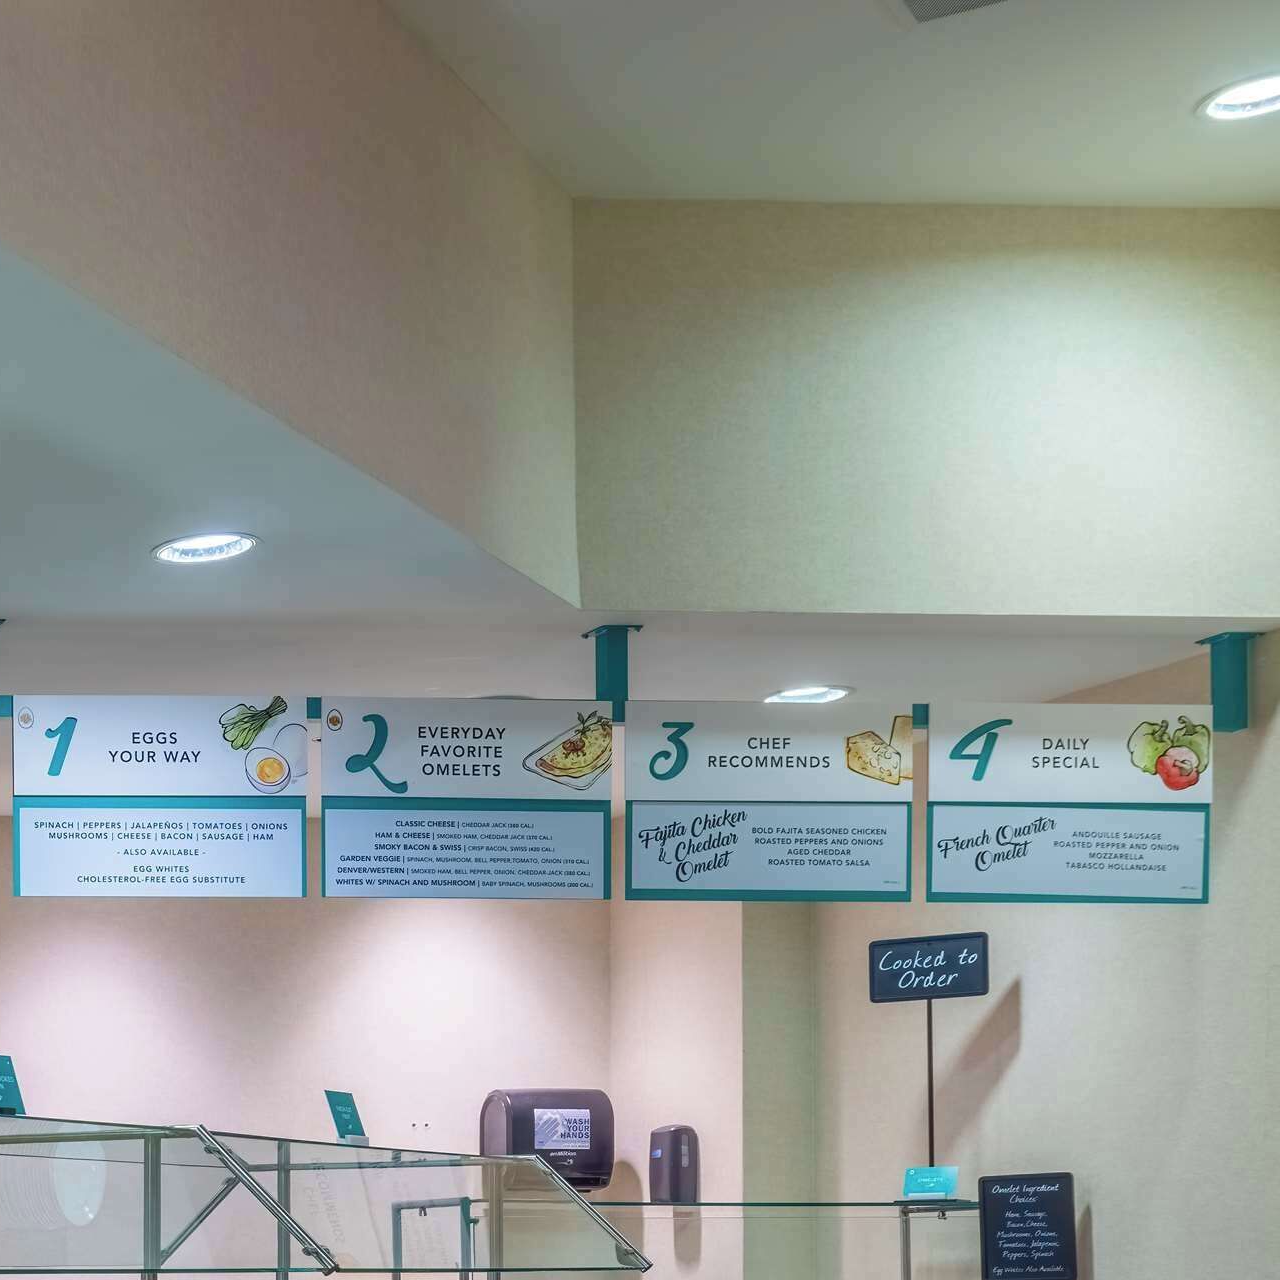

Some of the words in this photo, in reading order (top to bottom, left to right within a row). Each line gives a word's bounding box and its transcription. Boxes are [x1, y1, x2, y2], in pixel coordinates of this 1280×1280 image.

[131, 732, 178, 745] EGGS
[418, 726, 506, 739] EVERYDAY
[44, 717, 78, 776] 1
[747, 737, 791, 749] CHEF
[1042, 738, 1089, 750] DAILY
[108, 750, 156, 763] YOUR
[163, 751, 201, 763] WAY
[345, 714, 408, 794] 2
[420, 745, 503, 758] FAVORITE
[649, 722, 694, 780] 3
[949, 719, 1013, 781] 4
[708, 756, 830, 768] RECOMMENDS
[1032, 756, 1100, 769] SPECIAL
[422, 763, 501, 777] OMELETS
[34, 821, 74, 829] SPINACH
[83, 822, 121, 830] PEPPERS
[131, 820, 184, 830] JALAPEÑOS
[192, 822, 243, 830] TOMATOES
[251, 822, 288, 830] ONIONS
[638, 821, 686, 849] Fajita
[690, 809, 748, 838] Chicken
[48, 832, 108, 840] MUSHROOMS
[117, 832, 152, 840] CHEESE
[160, 832, 193, 840] BACON
[202, 832, 244, 841] SAUSAGE
[253, 833, 274, 841] HAM
[937, 829, 992, 859] French
[995, 816, 1057, 846] Quarter
[1072, 831, 1120, 839] ANDOUILLE
[1122, 832, 1162, 840] SAUSAGE
[658, 848, 672, 864] &
[674, 831, 738, 862] Cheddar
[975, 840, 1033, 872] Omelet
[1088, 852, 1144, 860] MOZZARELLA
[133, 865, 153, 873] EGG
[155, 865, 190, 873] WHITES
[675, 850, 734, 883] Omelet
[1065, 862, 1105, 870] TABASCO
[1107, 864, 1167, 872] HOLLANDAISE
[170, 876, 189, 884] EGG
[192, 876, 245, 884] SUBSTITUTE
[879, 950, 947, 971] Cooked
[958, 948, 978, 965] to
[898, 970, 958, 989] Order
[991, 1184, 1020, 1193] Omelet
[1022, 1184, 1060, 1196] Ingredient
